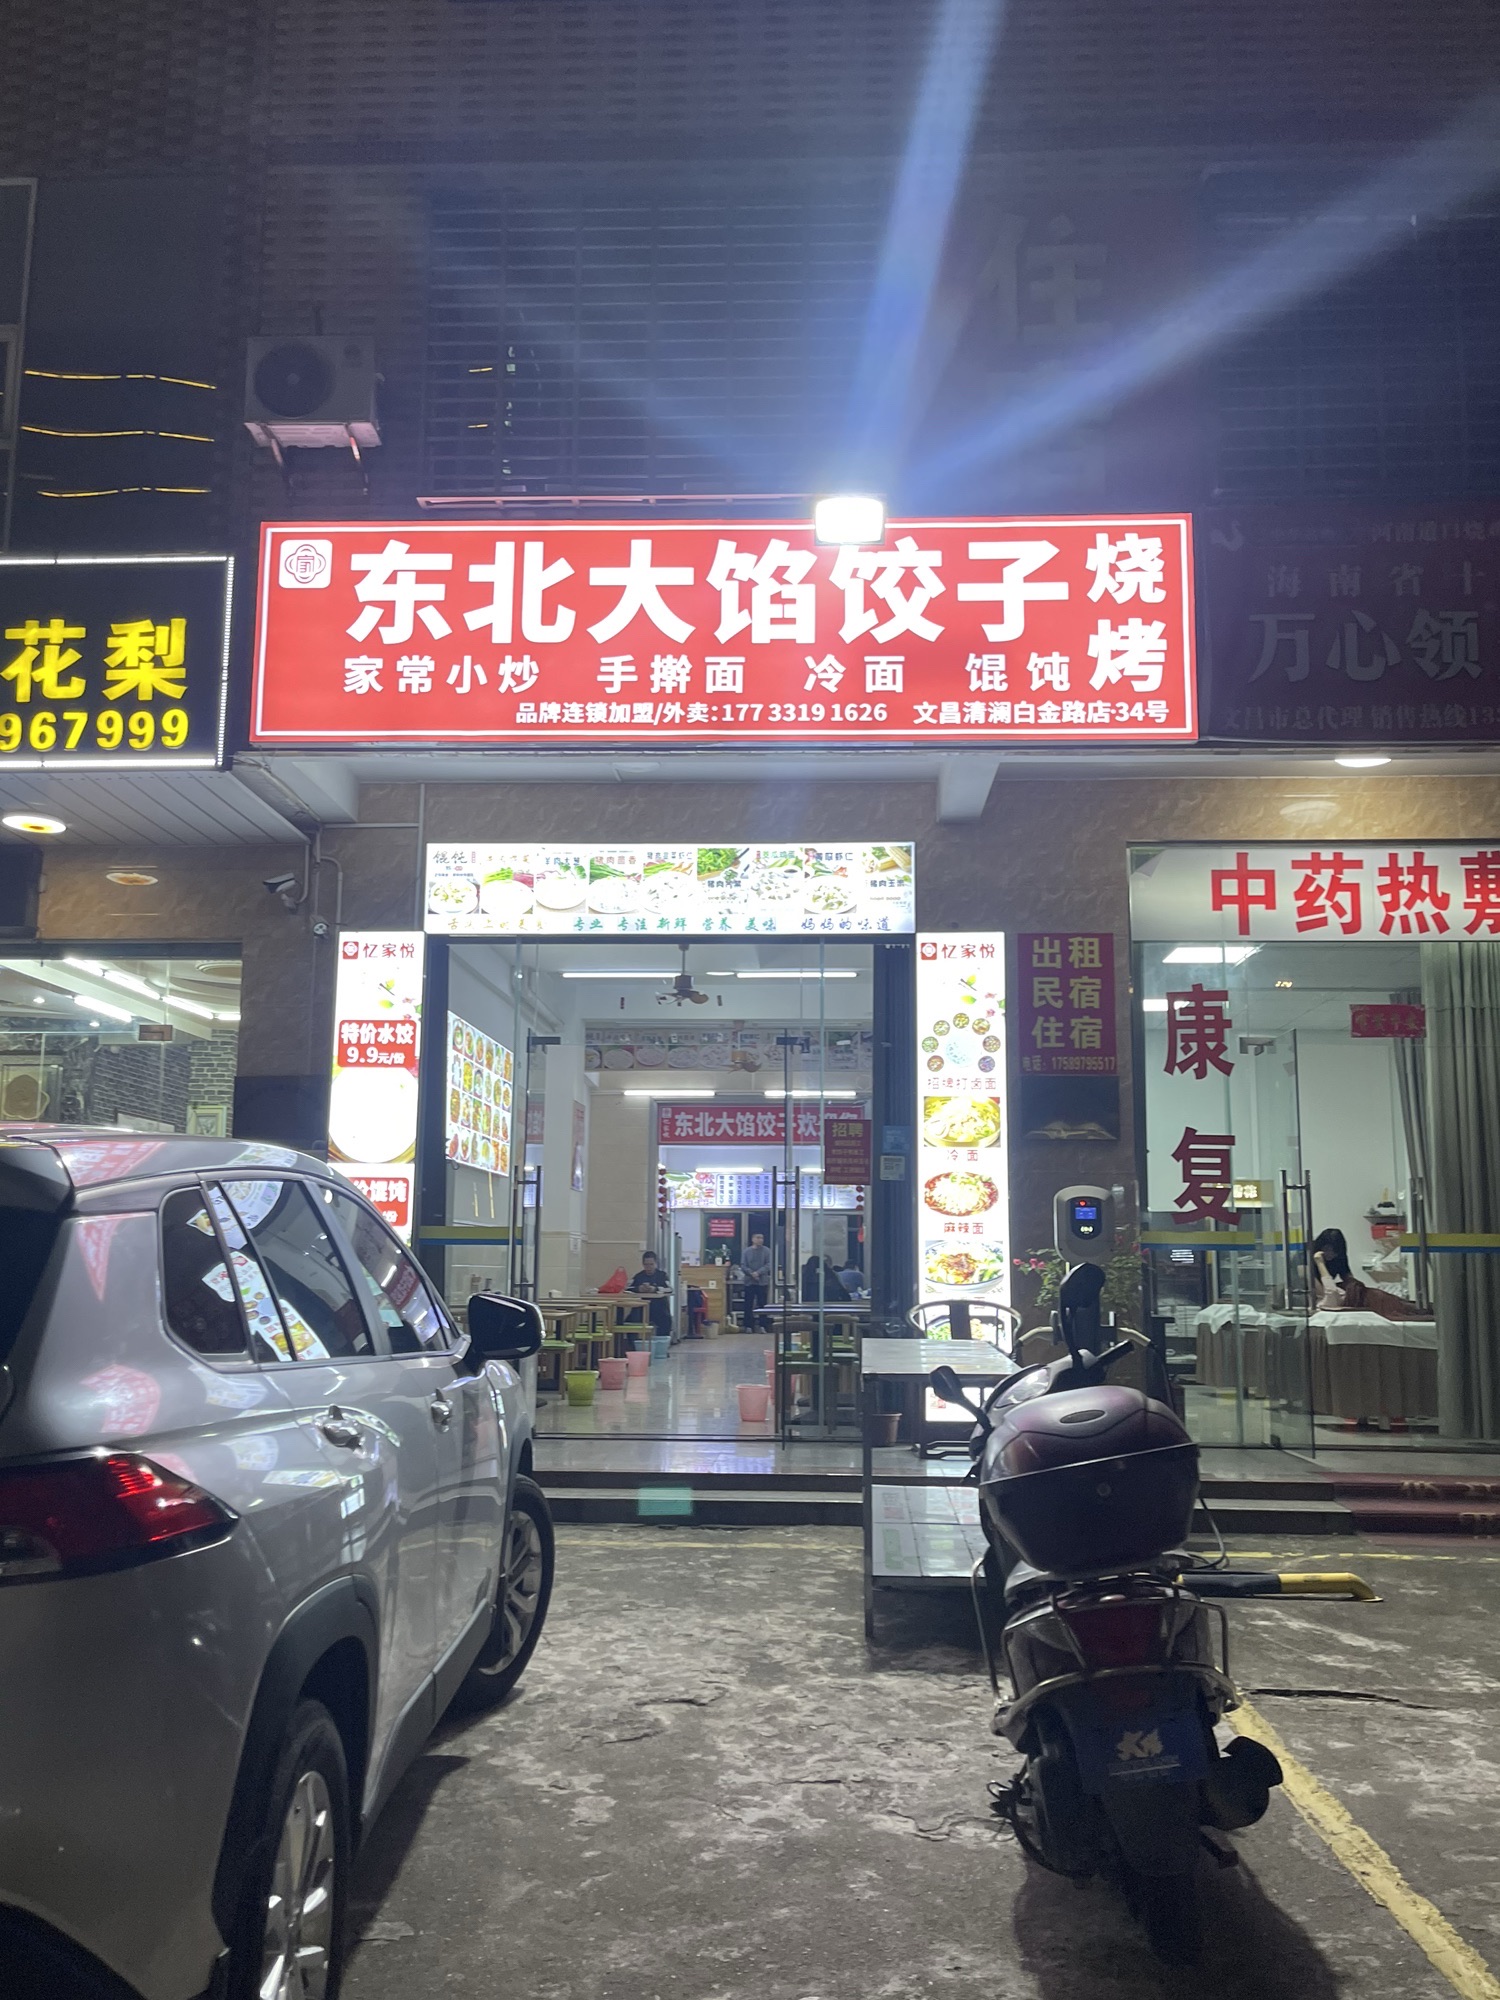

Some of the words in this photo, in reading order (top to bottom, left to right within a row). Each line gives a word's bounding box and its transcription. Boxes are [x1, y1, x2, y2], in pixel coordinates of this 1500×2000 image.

[345, 538, 1069, 645] 东北大馅饺子
[1085, 532, 1167, 692] 烧烤
[1248, 607, 1484, 685] 万心领
[0, 617, 188, 703] 花梨
[803, 653, 905, 694] 冷面
[963, 651, 1071, 693] 馄饨
[342, 653, 540, 695] 家常小炒
[596, 653, 746, 695] 手擀面
[0, 708, 189, 751] 967999
[573, 916, 605, 931] 专业
[616, 916, 649, 931] 专注
[656, 917, 688, 931] 新鲜
[701, 917, 733, 931] 营养
[744, 917, 777, 931] 美味
[800, 916, 892, 932] 妈妈的味道
[362, 942, 415, 959] 忆家悦
[941, 943, 995, 959] 忆家悦
[1031, 936, 1103, 969] 出租
[1032, 976, 1102, 1009] 民宿
[340, 1022, 414, 1045] 特价水饺
[1031, 1016, 1103, 1049] 住宿
[346, 1047, 406, 1065] 9.9元/份
[1164, 983, 1241, 1226] 康复
[674, 1111, 858, 1138] 东北大馅饺子欢
[832, 1122, 864, 1138] 招聘
[946, 1149, 979, 1162] 冷面
[944, 1222, 984, 1235] 麻辣面
